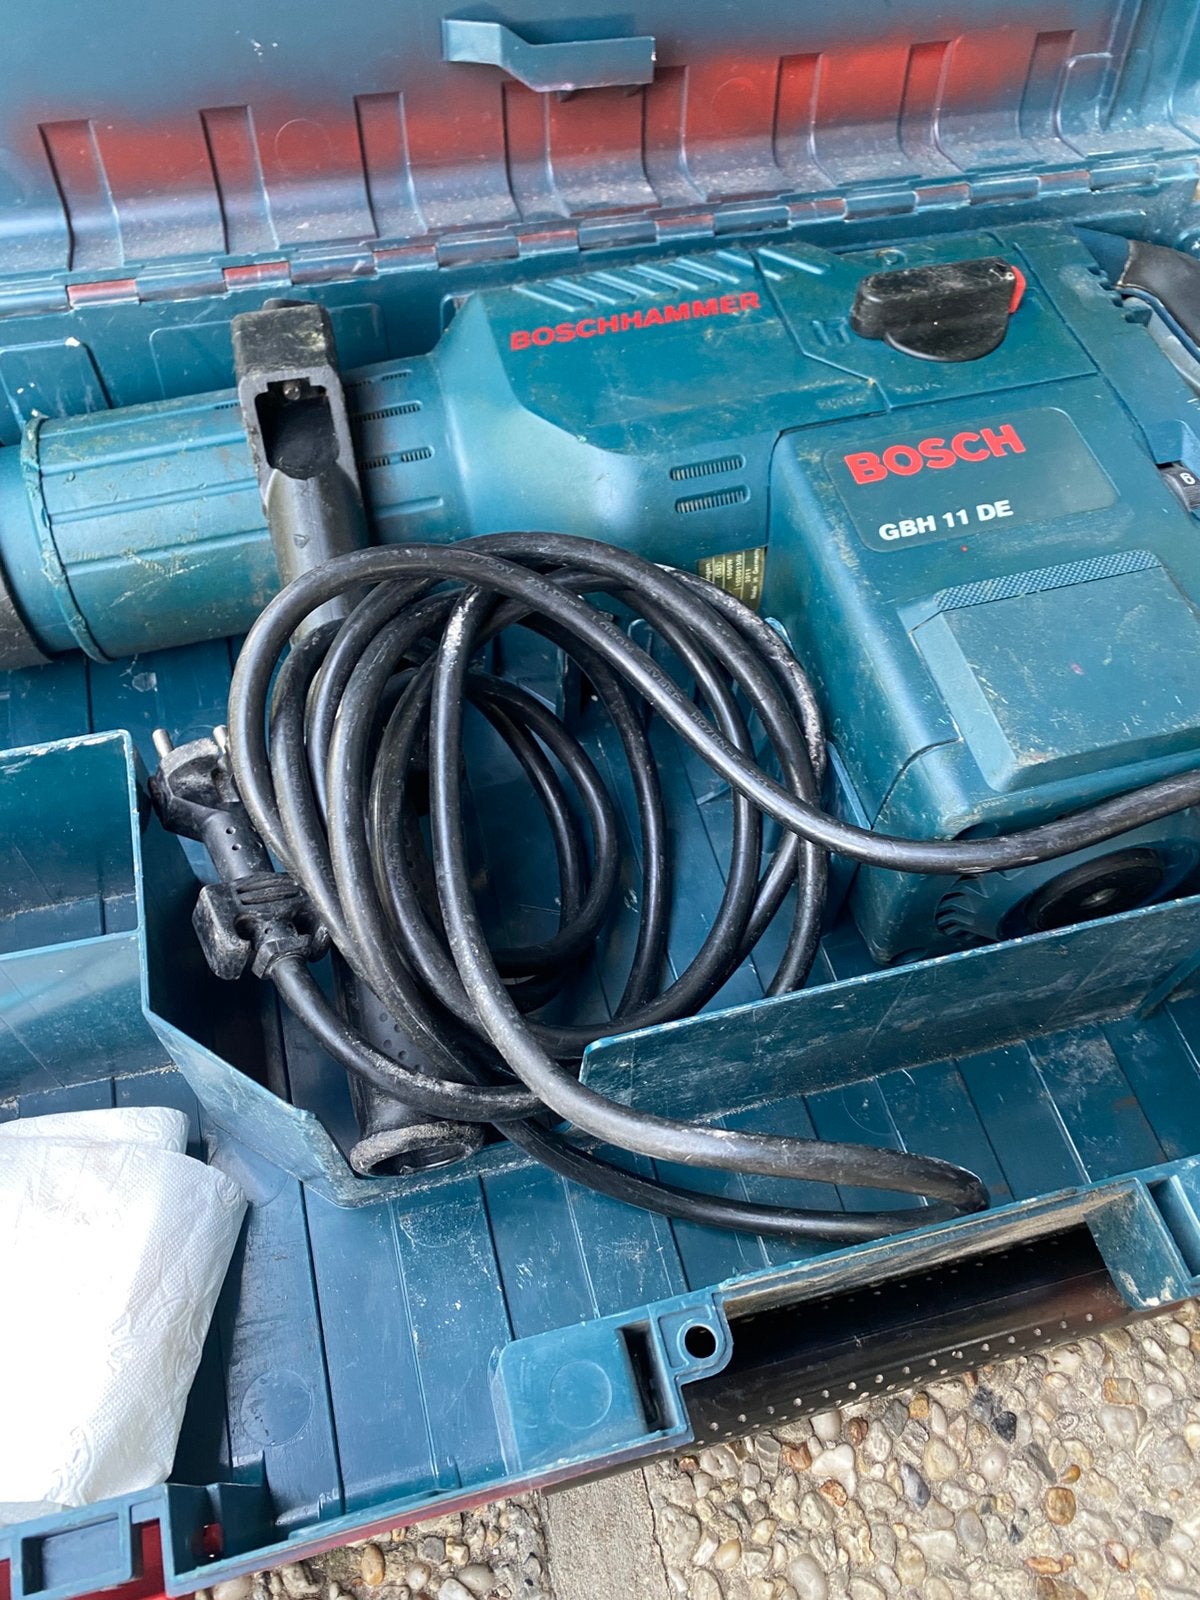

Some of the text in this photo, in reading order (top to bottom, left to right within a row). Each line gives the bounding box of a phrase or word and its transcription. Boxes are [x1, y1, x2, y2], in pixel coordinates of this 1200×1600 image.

[510, 292, 761, 351] BOSCHHAMMER
[843, 423, 1027, 485] BOSCH
[1180, 472, 1196, 485] 6
[878, 499, 1015, 541] GBH 11 DE
